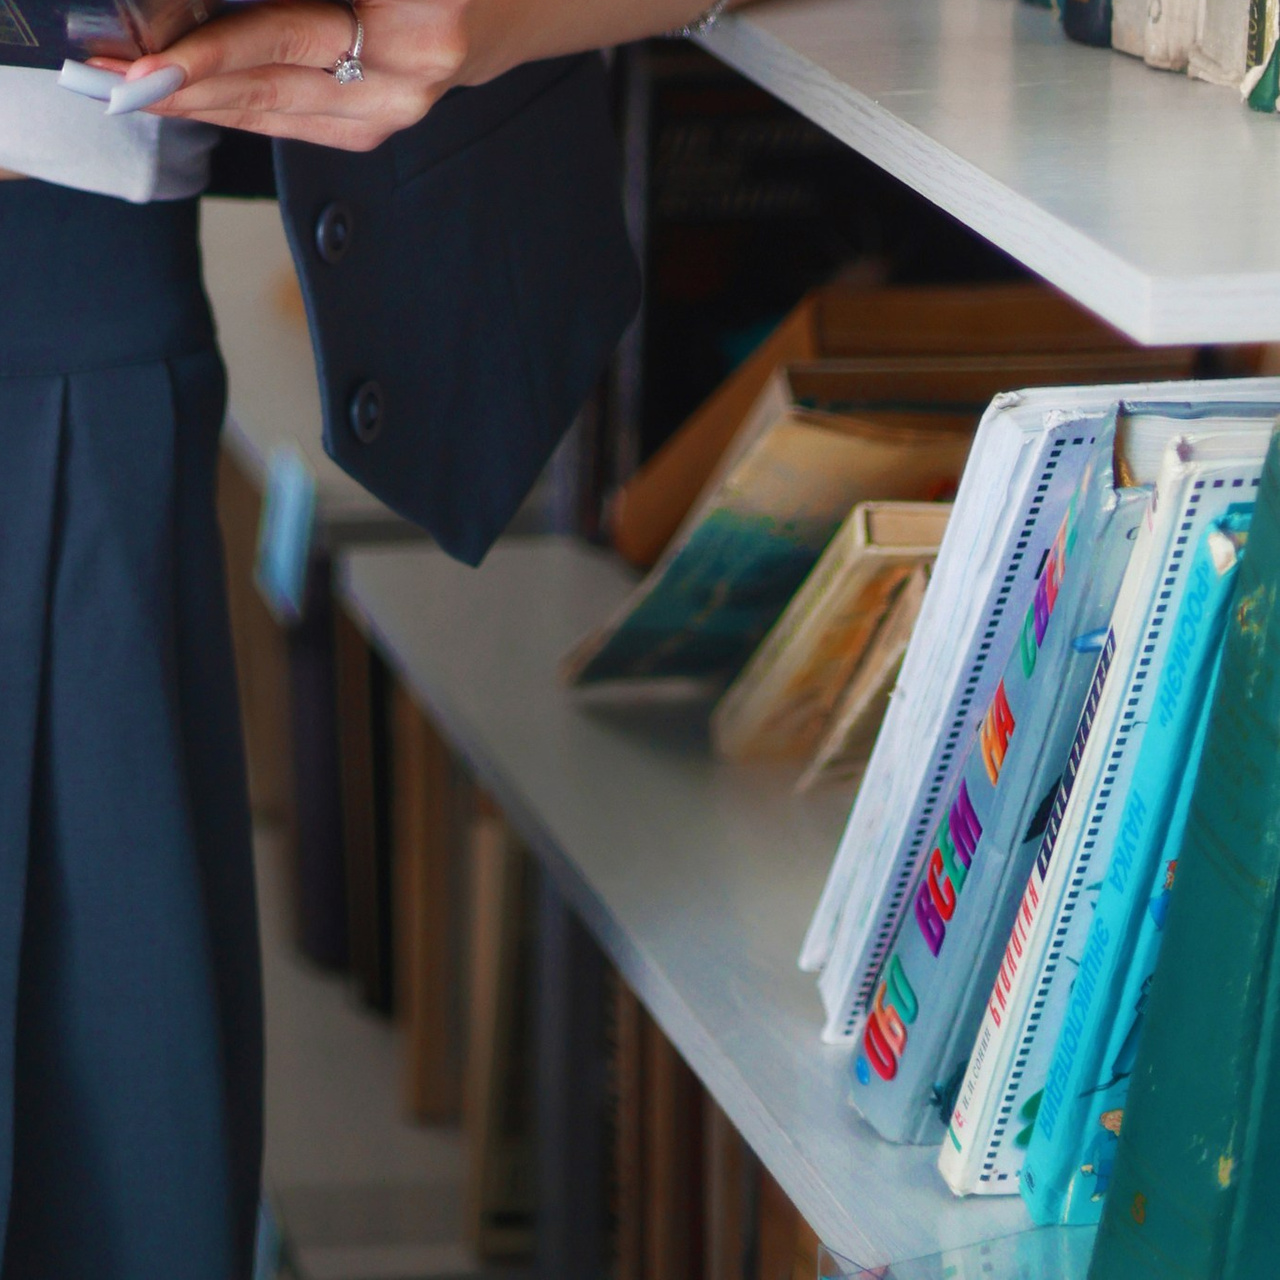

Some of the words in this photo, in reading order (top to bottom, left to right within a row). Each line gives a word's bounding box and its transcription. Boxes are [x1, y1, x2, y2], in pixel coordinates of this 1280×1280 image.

[863, 953, 919, 1082] ОБО
[914, 777, 983, 958] ВСЕМ
[979, 676, 1016, 787] НА
[1110, 788, 1147, 895] НАУКА
[987, 875, 1039, 1028] БИОЛОГИЯ
[1038, 916, 1110, 1142] ЭНЦИКЛОПЕДИЯ
